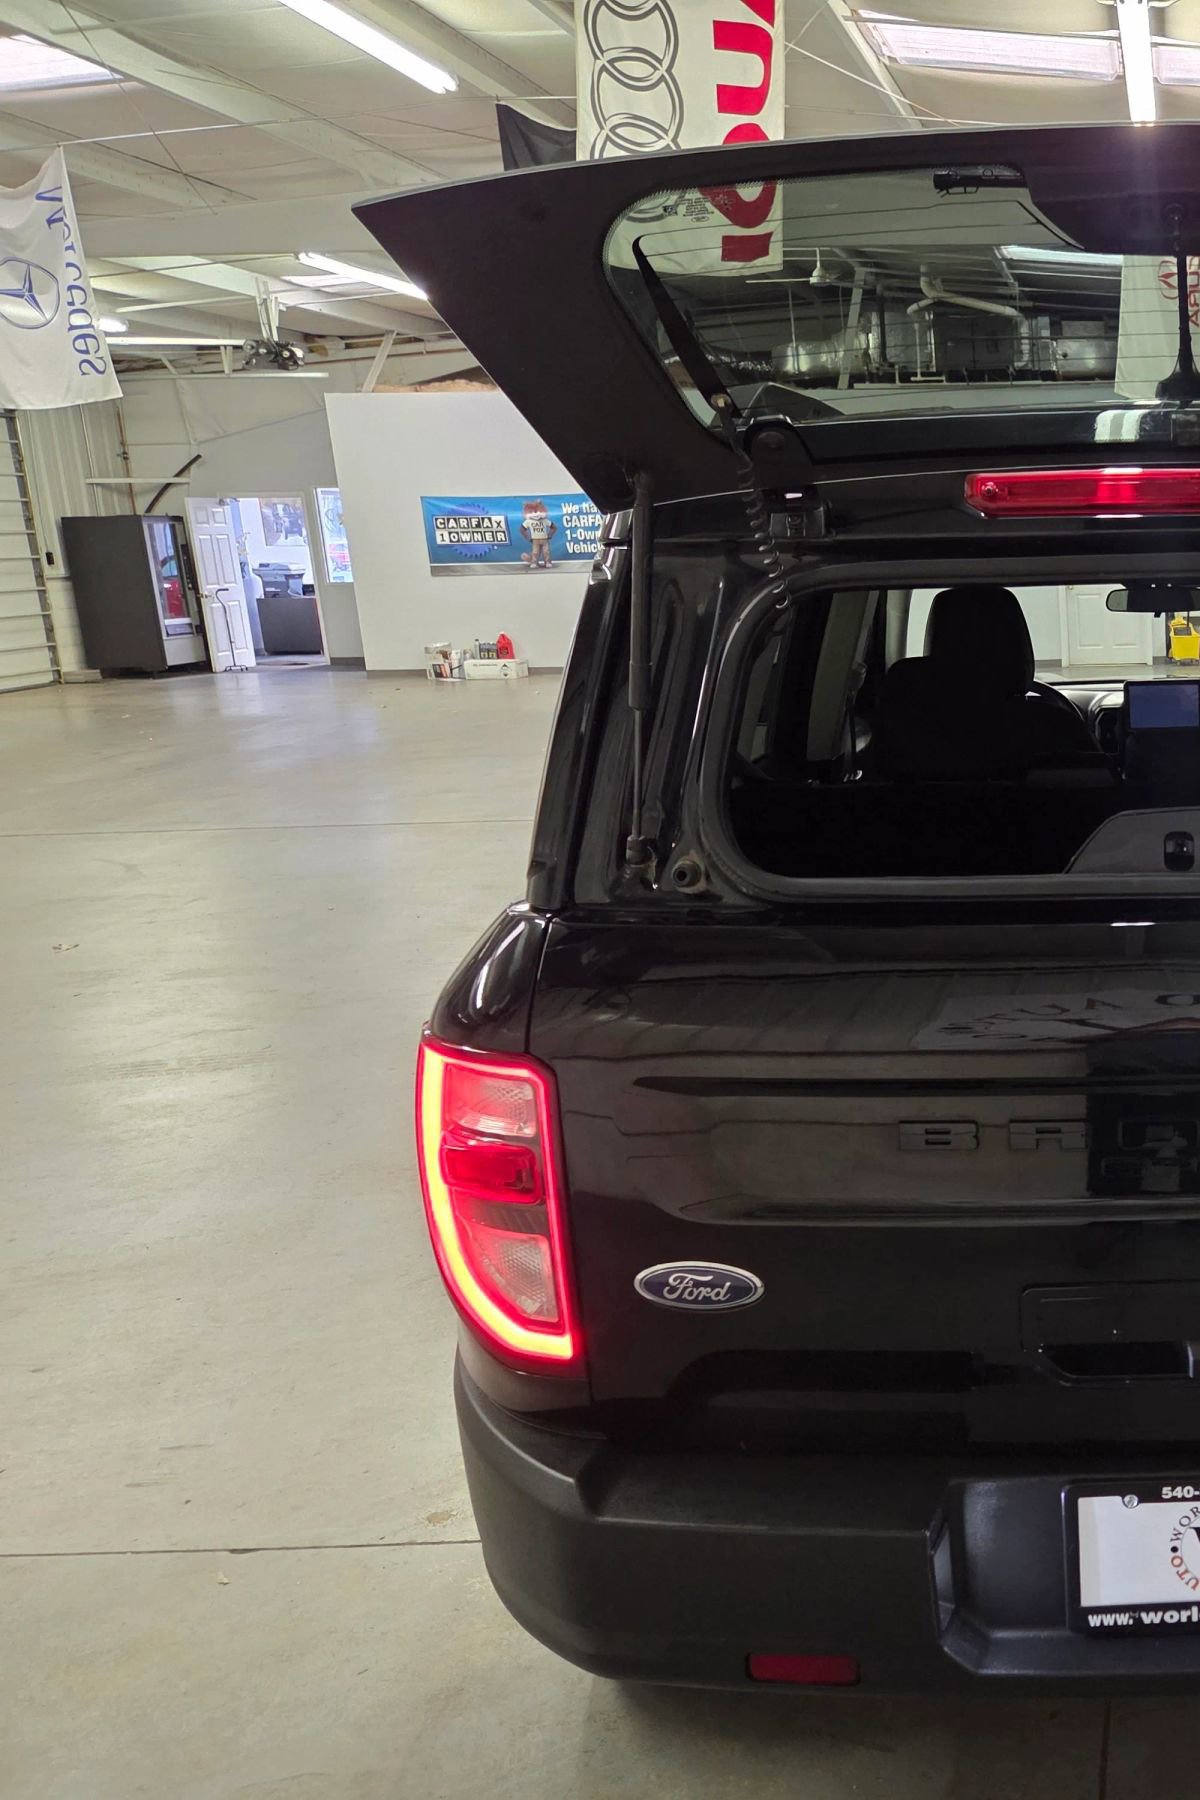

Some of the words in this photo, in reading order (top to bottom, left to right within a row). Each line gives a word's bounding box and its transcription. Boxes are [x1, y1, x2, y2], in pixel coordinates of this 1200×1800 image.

[561, 503, 579, 514] We
[582, 502, 598, 513] ha
[436, 517, 505, 529] CARFAX
[562, 514, 602, 528] CARFA
[565, 529, 601, 540] 1-Own
[663, 1272, 732, 1301] Ford
